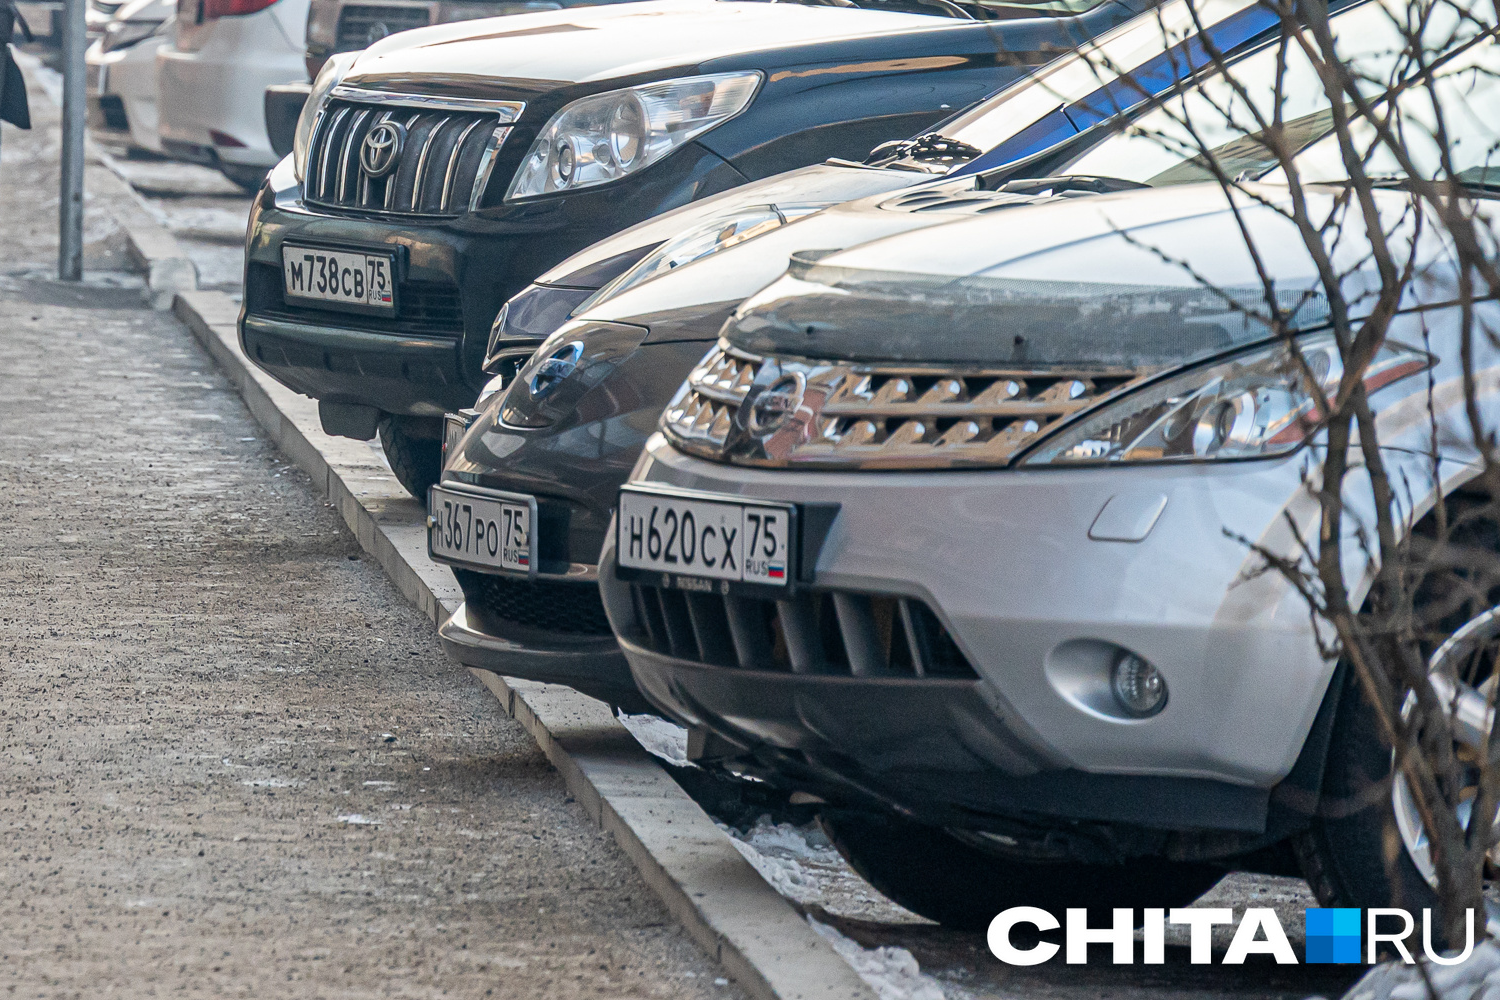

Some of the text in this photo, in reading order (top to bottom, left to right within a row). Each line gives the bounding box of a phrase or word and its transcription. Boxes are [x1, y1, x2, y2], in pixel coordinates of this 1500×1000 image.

[290, 254, 386, 298] М738СВ 75
[369, 290, 382, 301] RUS
[503, 509, 523, 547] 75
[630, 506, 777, 571] Н620СХ 75
[503, 548, 518, 563] RUS
[746, 559, 768, 576] RUS
